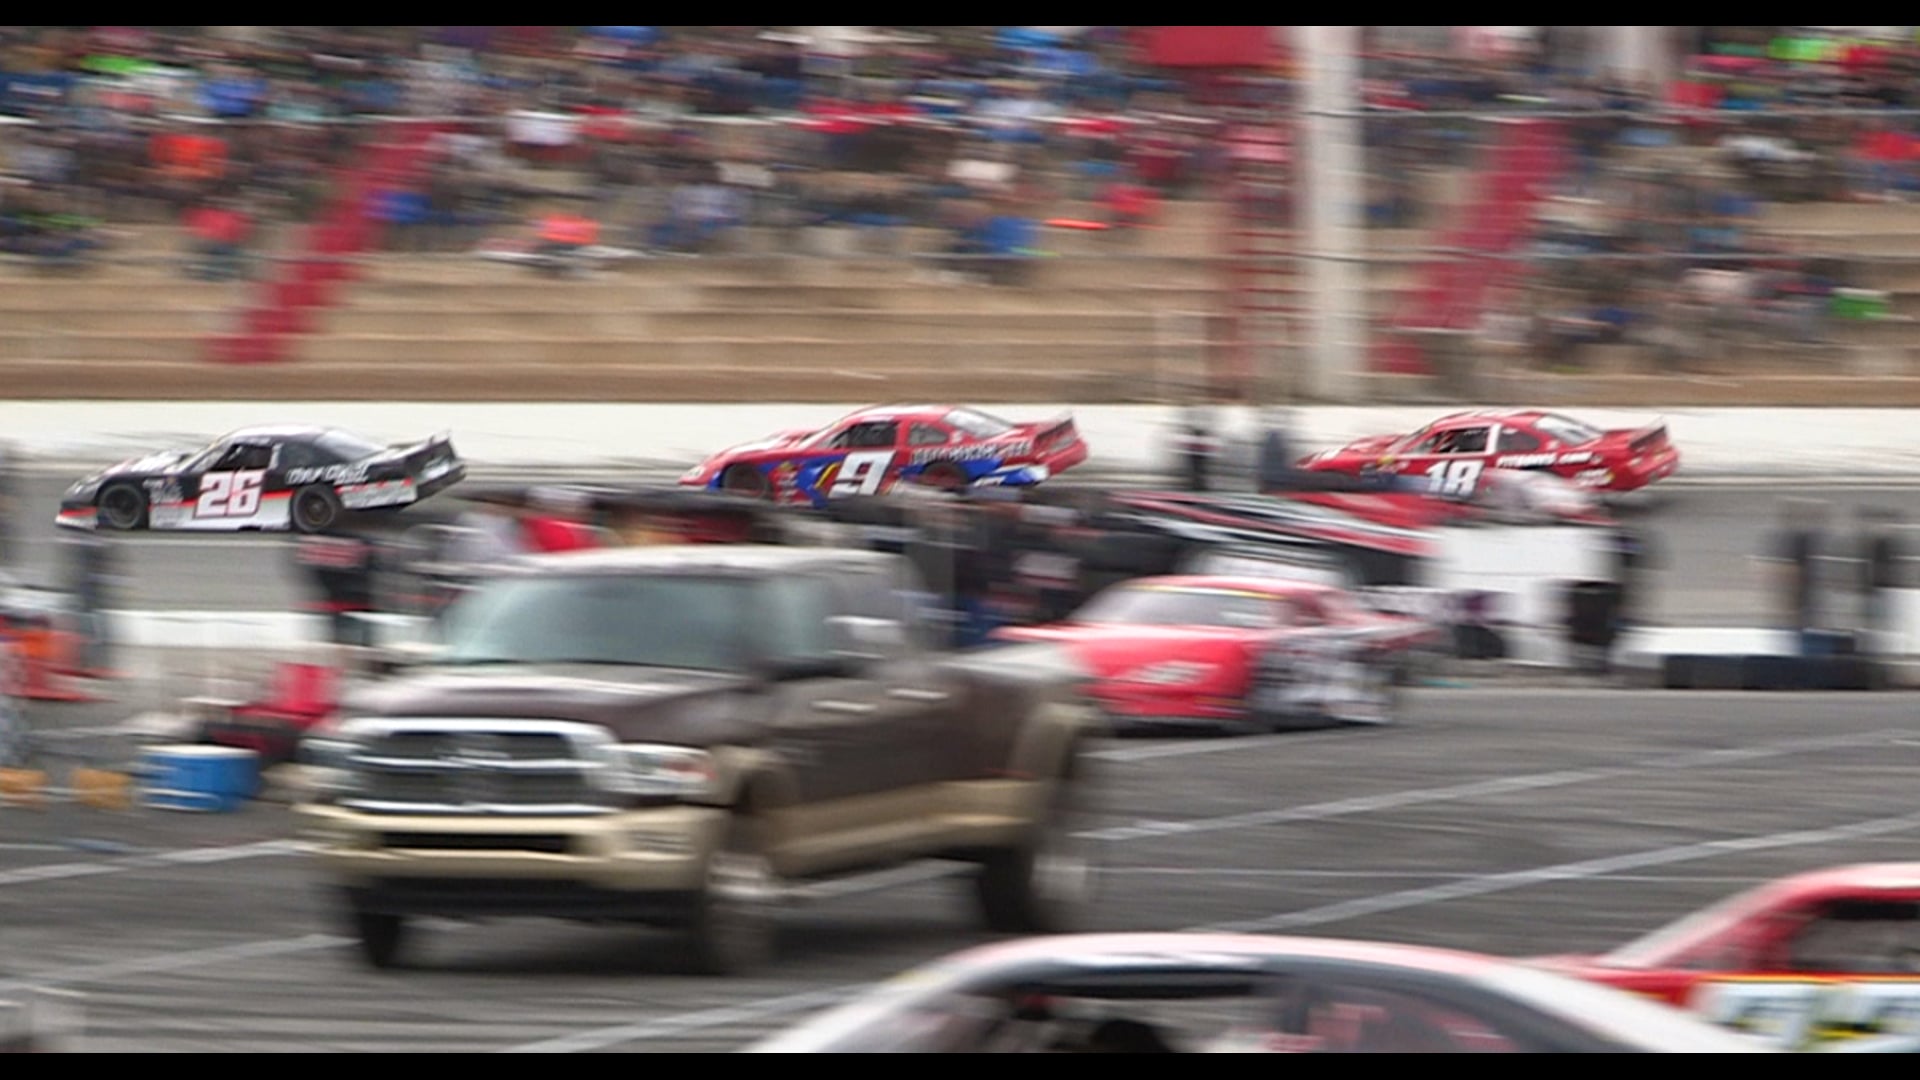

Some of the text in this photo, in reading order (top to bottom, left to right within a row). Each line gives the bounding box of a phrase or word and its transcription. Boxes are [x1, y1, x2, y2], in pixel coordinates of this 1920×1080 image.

[196, 470, 264, 518] 26
[828, 450, 896, 497] 9
[1425, 460, 1484, 495] 18
